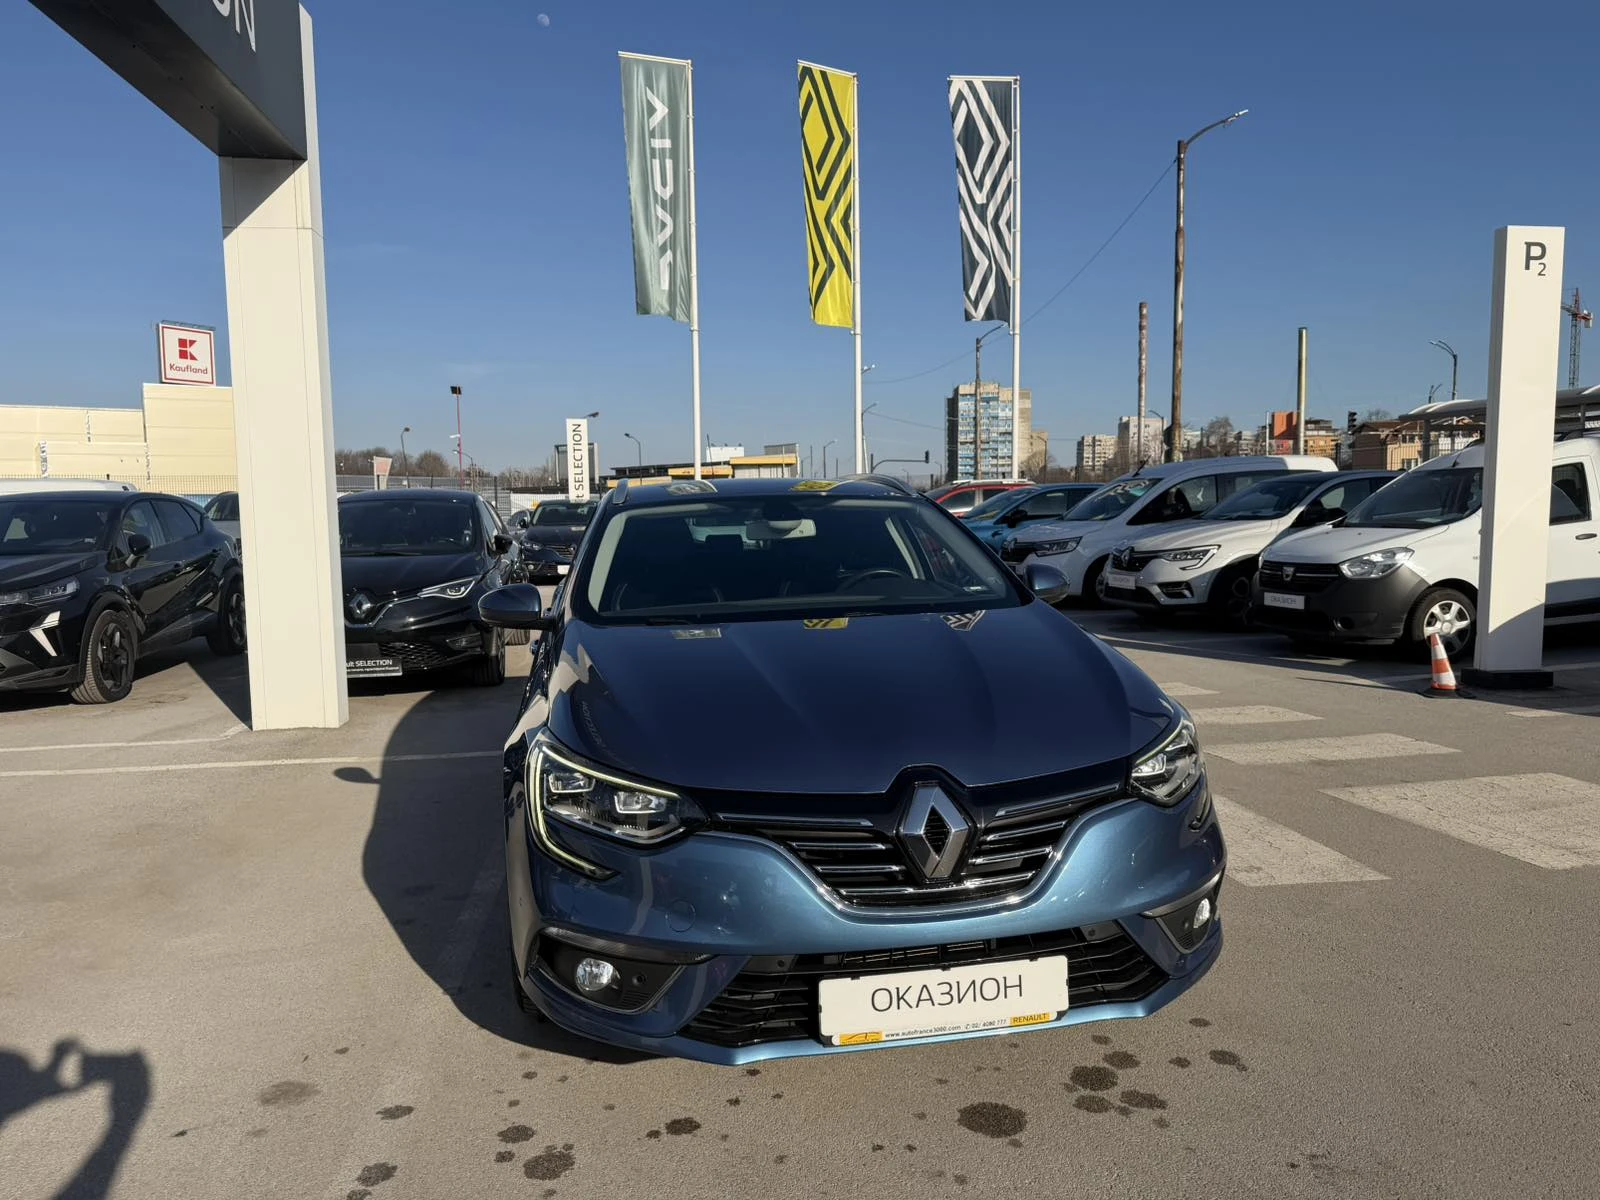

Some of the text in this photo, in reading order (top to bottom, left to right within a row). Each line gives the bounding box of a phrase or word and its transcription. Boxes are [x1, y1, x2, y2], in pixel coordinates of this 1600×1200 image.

[169, 363, 208, 375] Kaufland
[572, 423, 584, 491] SELECTION
[355, 659, 393, 667] SELECTION
[871, 974, 1023, 1012] ОКАЗИОН
[1012, 1013, 1047, 1024] RENAULT
